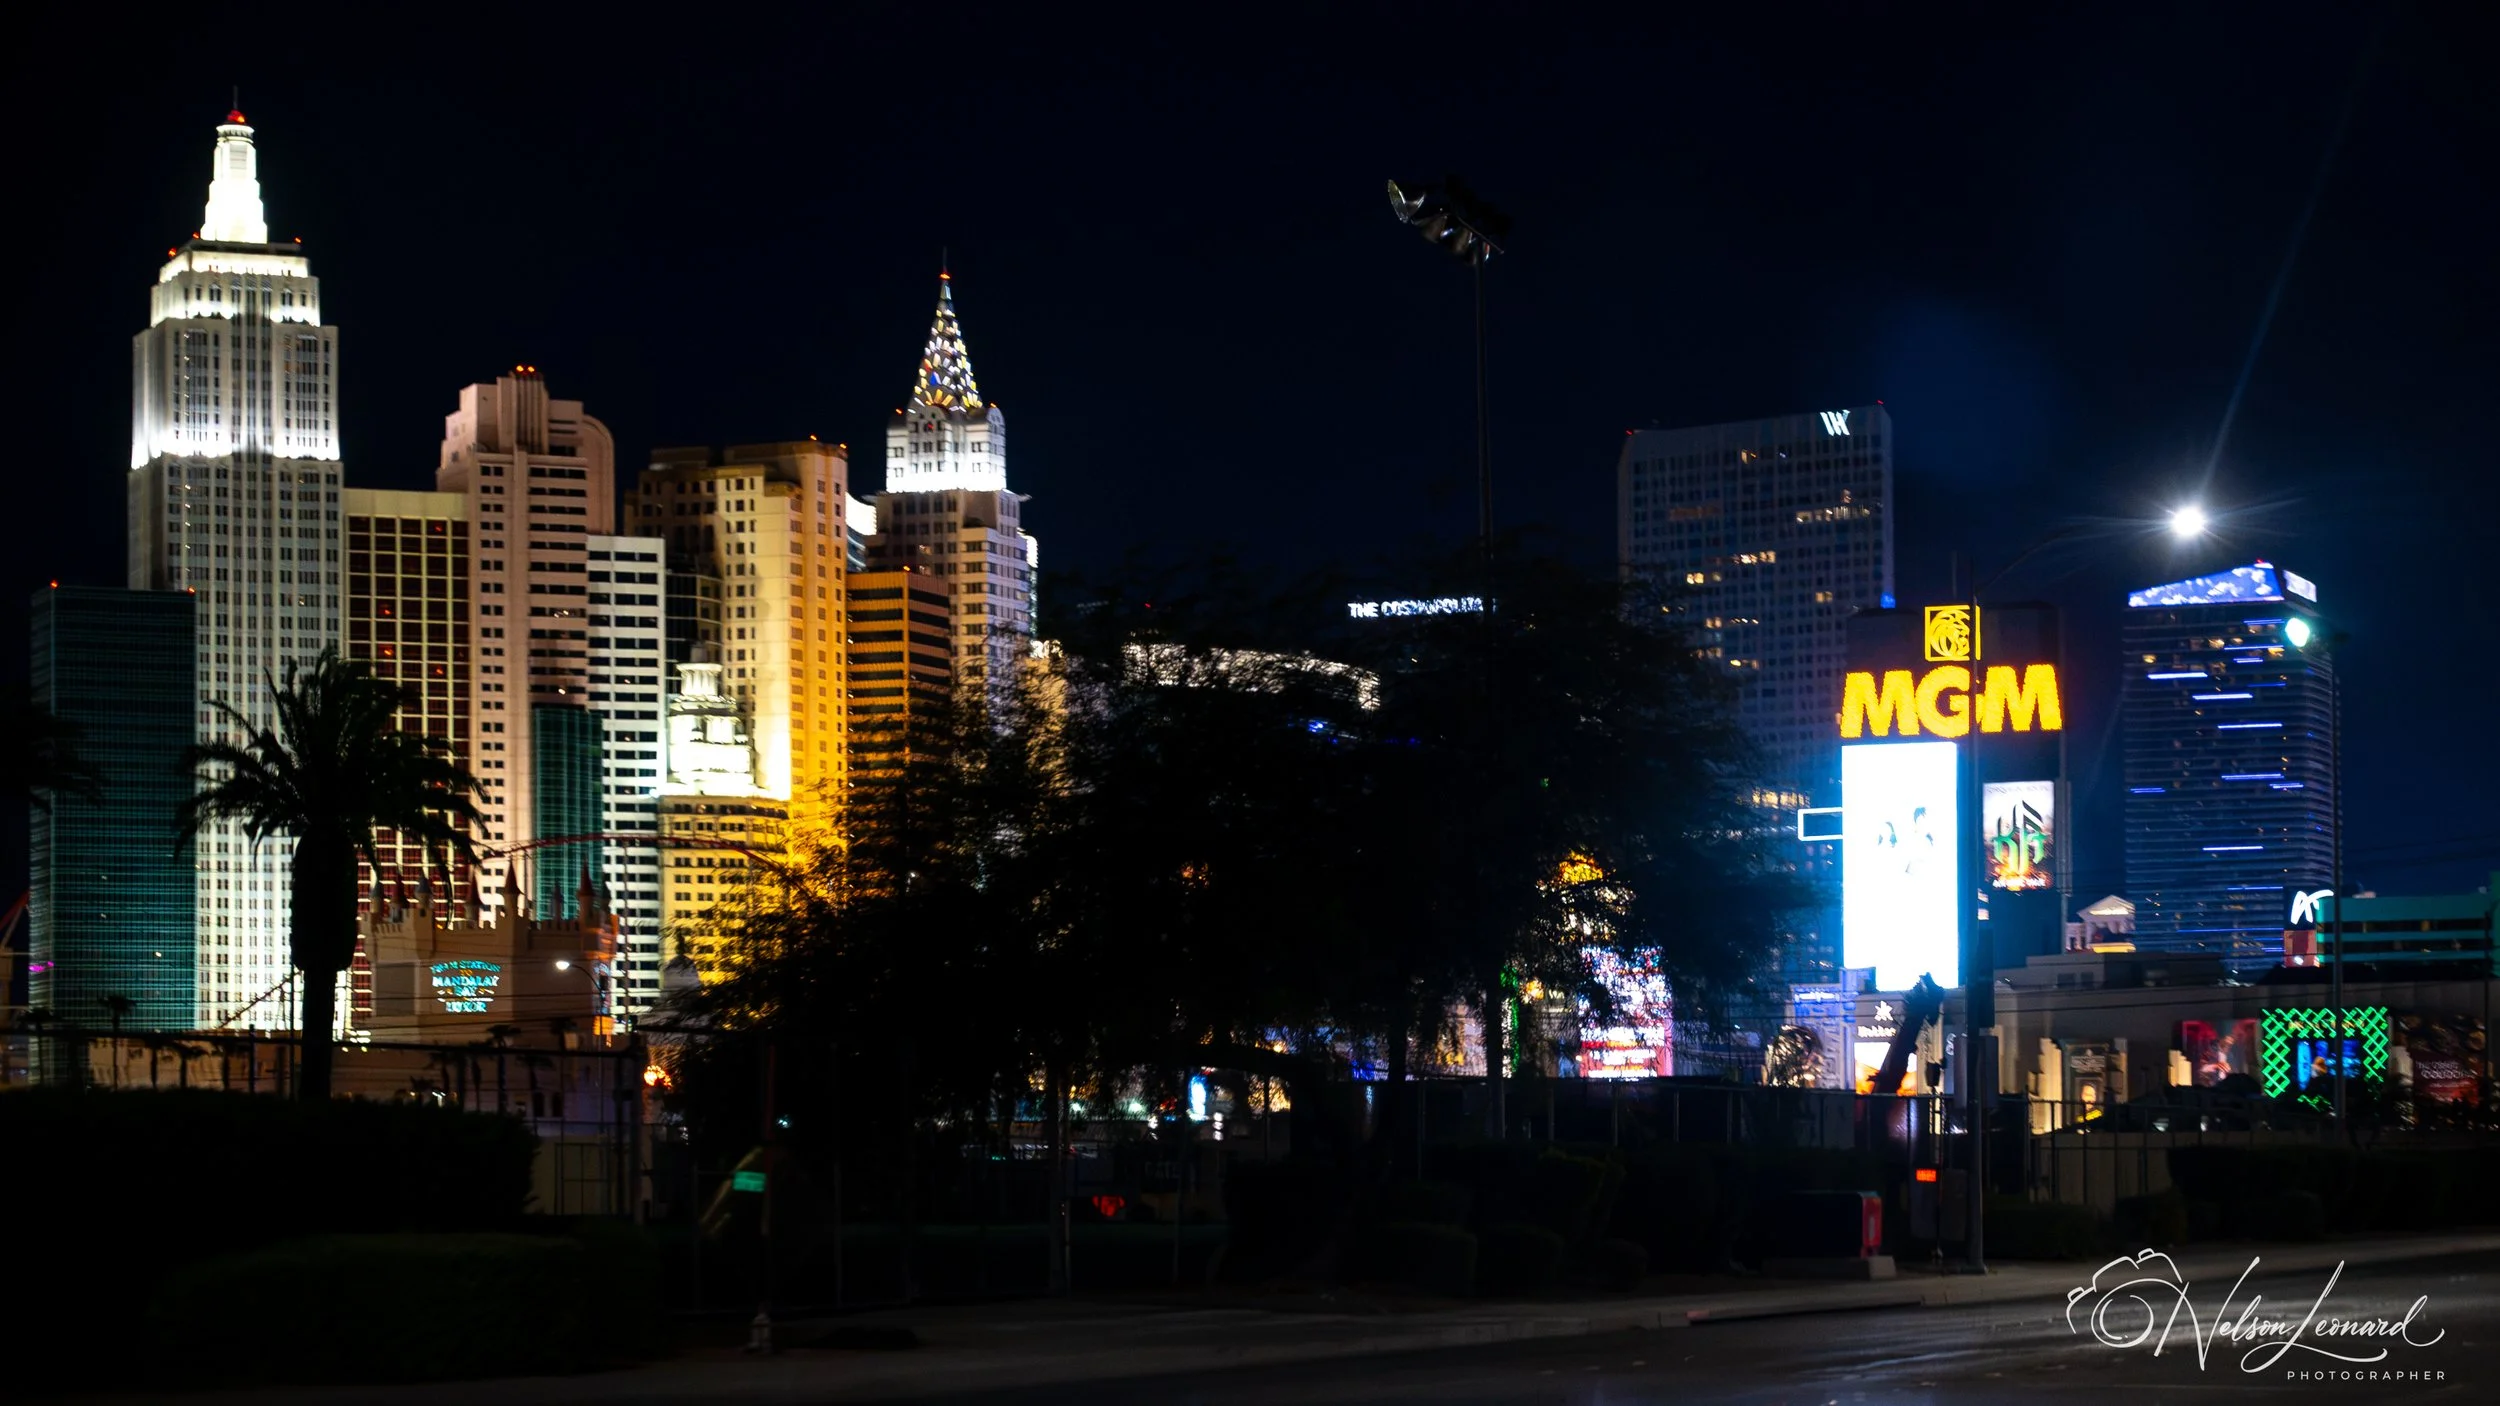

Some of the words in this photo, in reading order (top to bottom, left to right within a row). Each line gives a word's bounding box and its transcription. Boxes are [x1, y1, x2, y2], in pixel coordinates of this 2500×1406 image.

[1347, 602, 1379, 618] THE
[1840, 664, 2063, 738] MGM
[432, 976, 499, 987] MANDALAY
[454, 986, 478, 996] BAY
[445, 1001, 487, 1012] LUXOR
